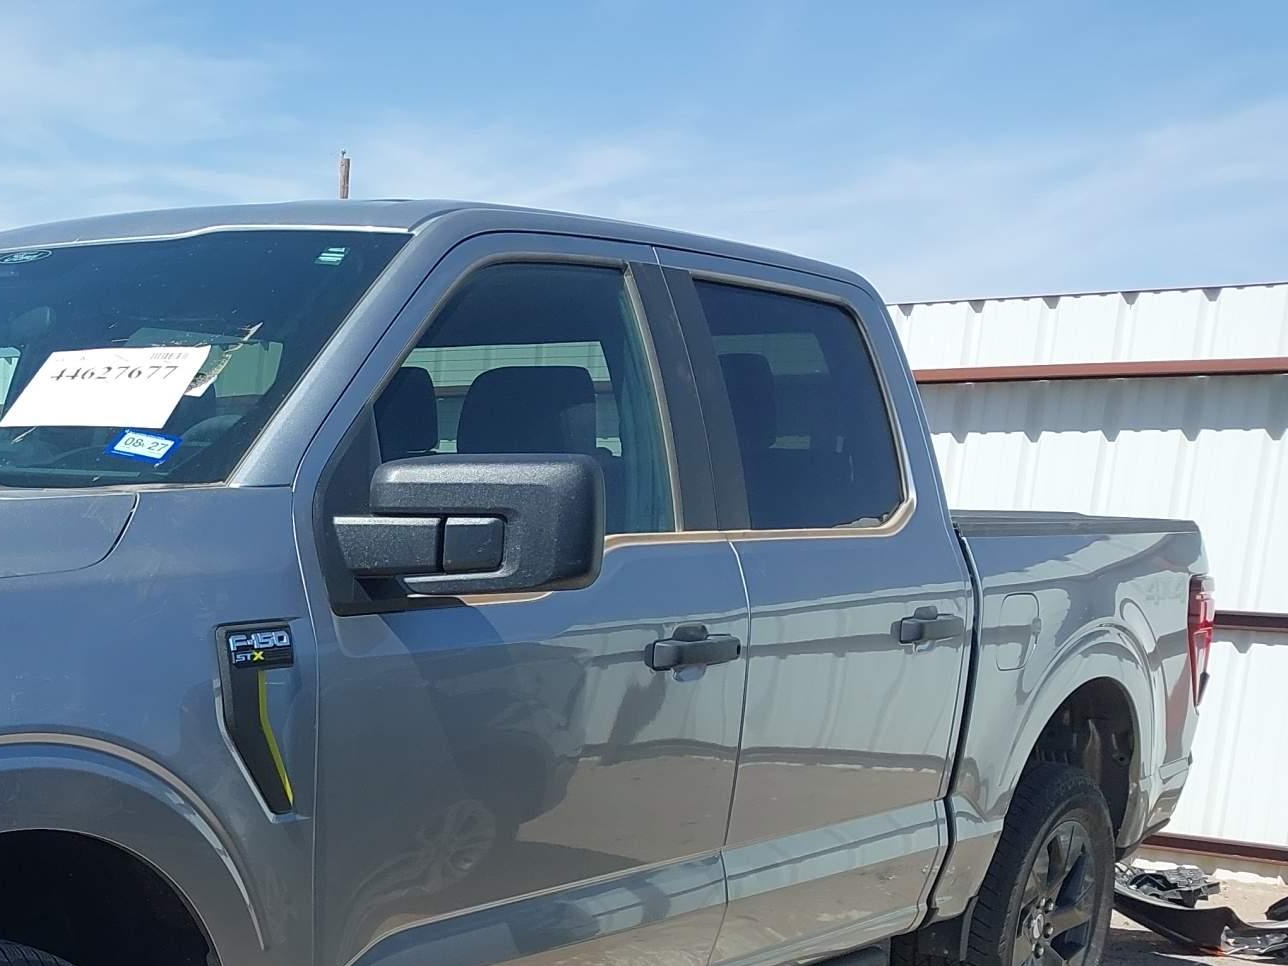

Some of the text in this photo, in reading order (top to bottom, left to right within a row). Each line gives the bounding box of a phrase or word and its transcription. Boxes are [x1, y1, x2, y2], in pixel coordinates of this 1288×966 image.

[50, 365, 179, 381] 44627677
[147, 441, 169, 452] 27
[228, 630, 291, 651] F-150
[235, 650, 265, 662] STX
